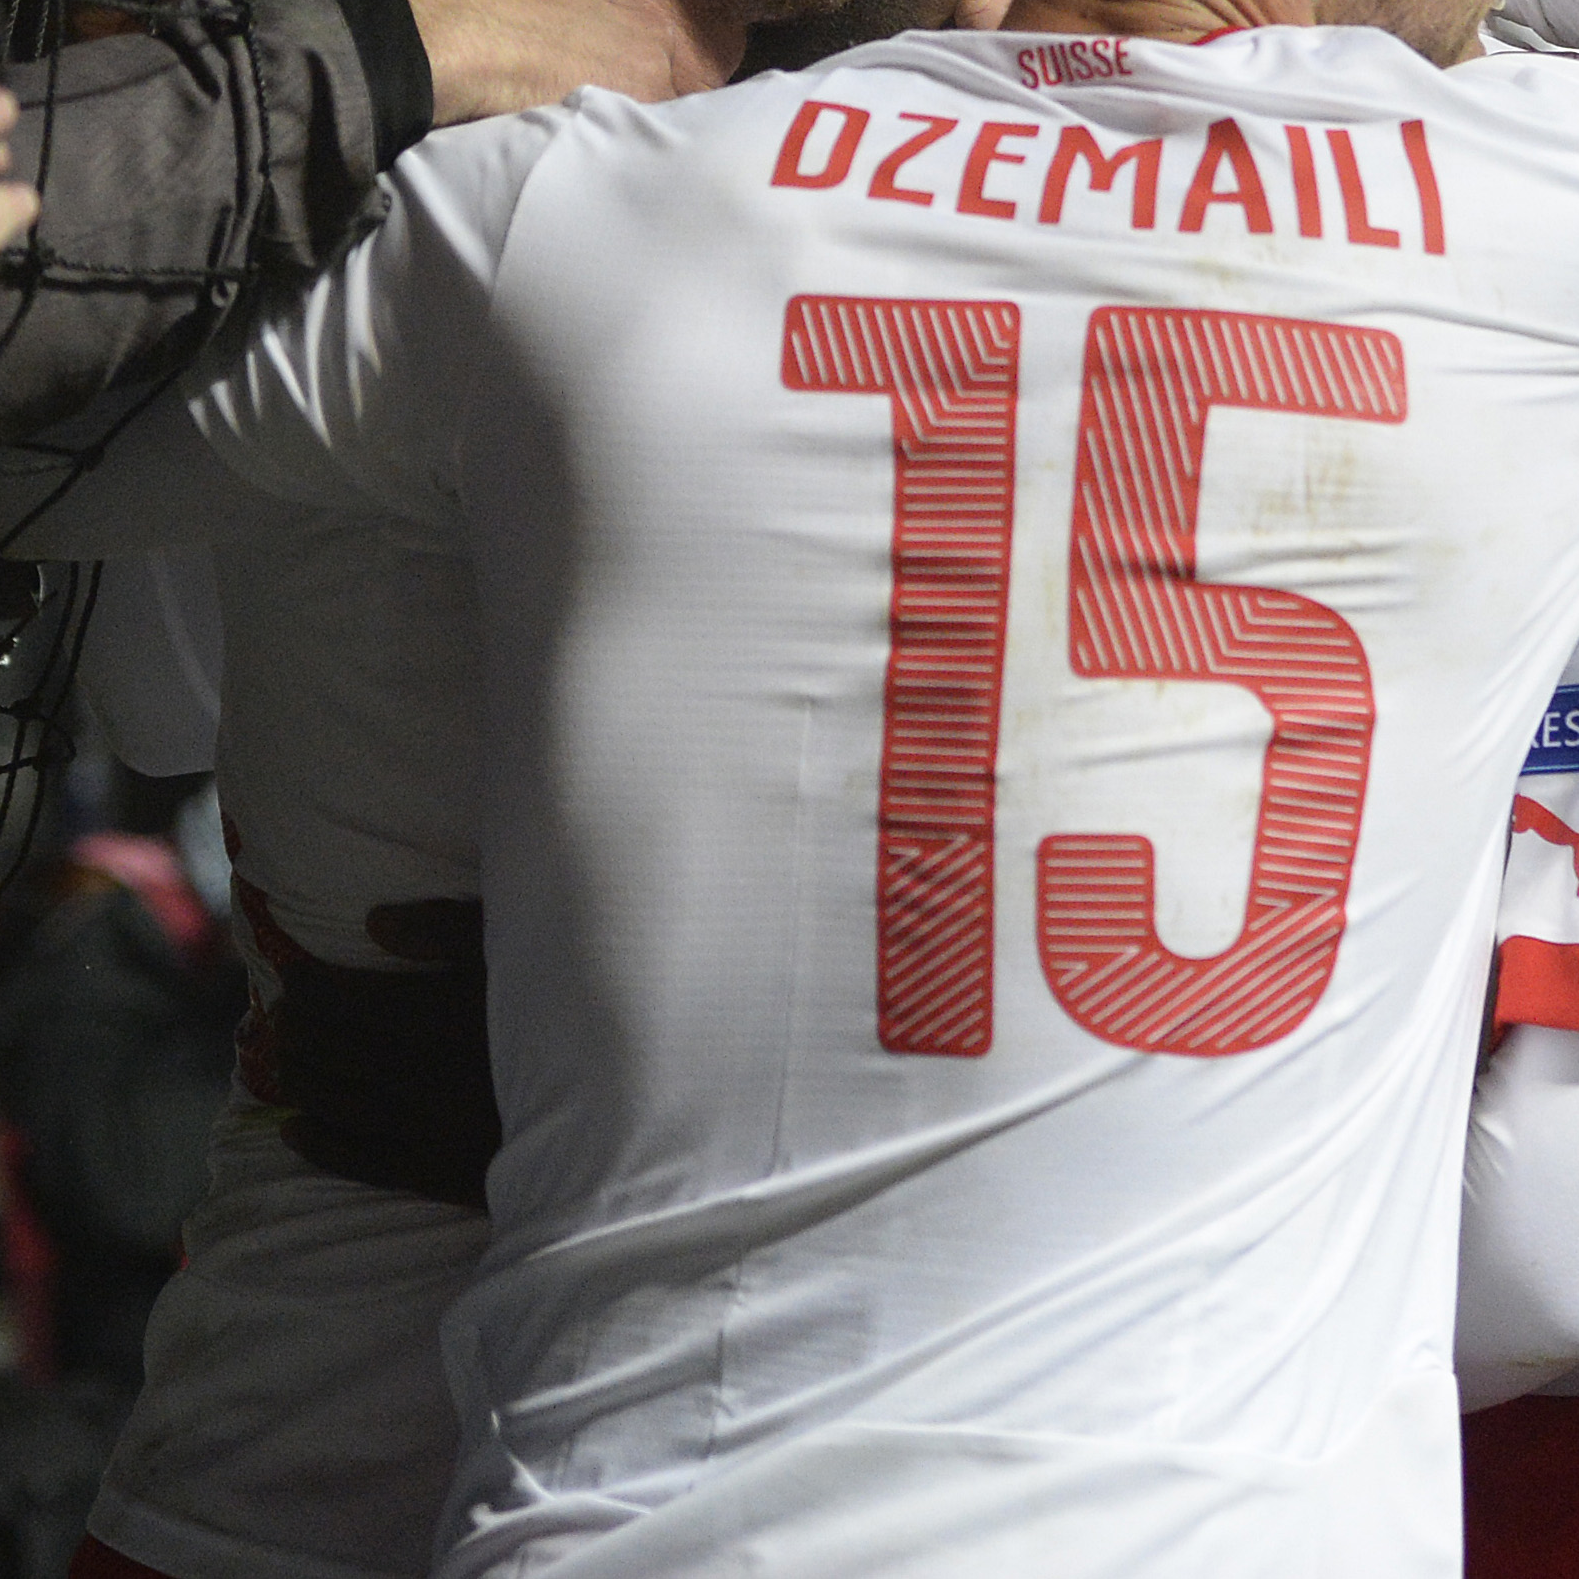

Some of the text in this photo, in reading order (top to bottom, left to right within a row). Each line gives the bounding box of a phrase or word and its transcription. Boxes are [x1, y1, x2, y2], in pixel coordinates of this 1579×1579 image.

[1018, 37, 1133, 89] SUISSE
[770, 100, 1446, 255] DZEMAILI
[780, 293, 1406, 1058] 15
